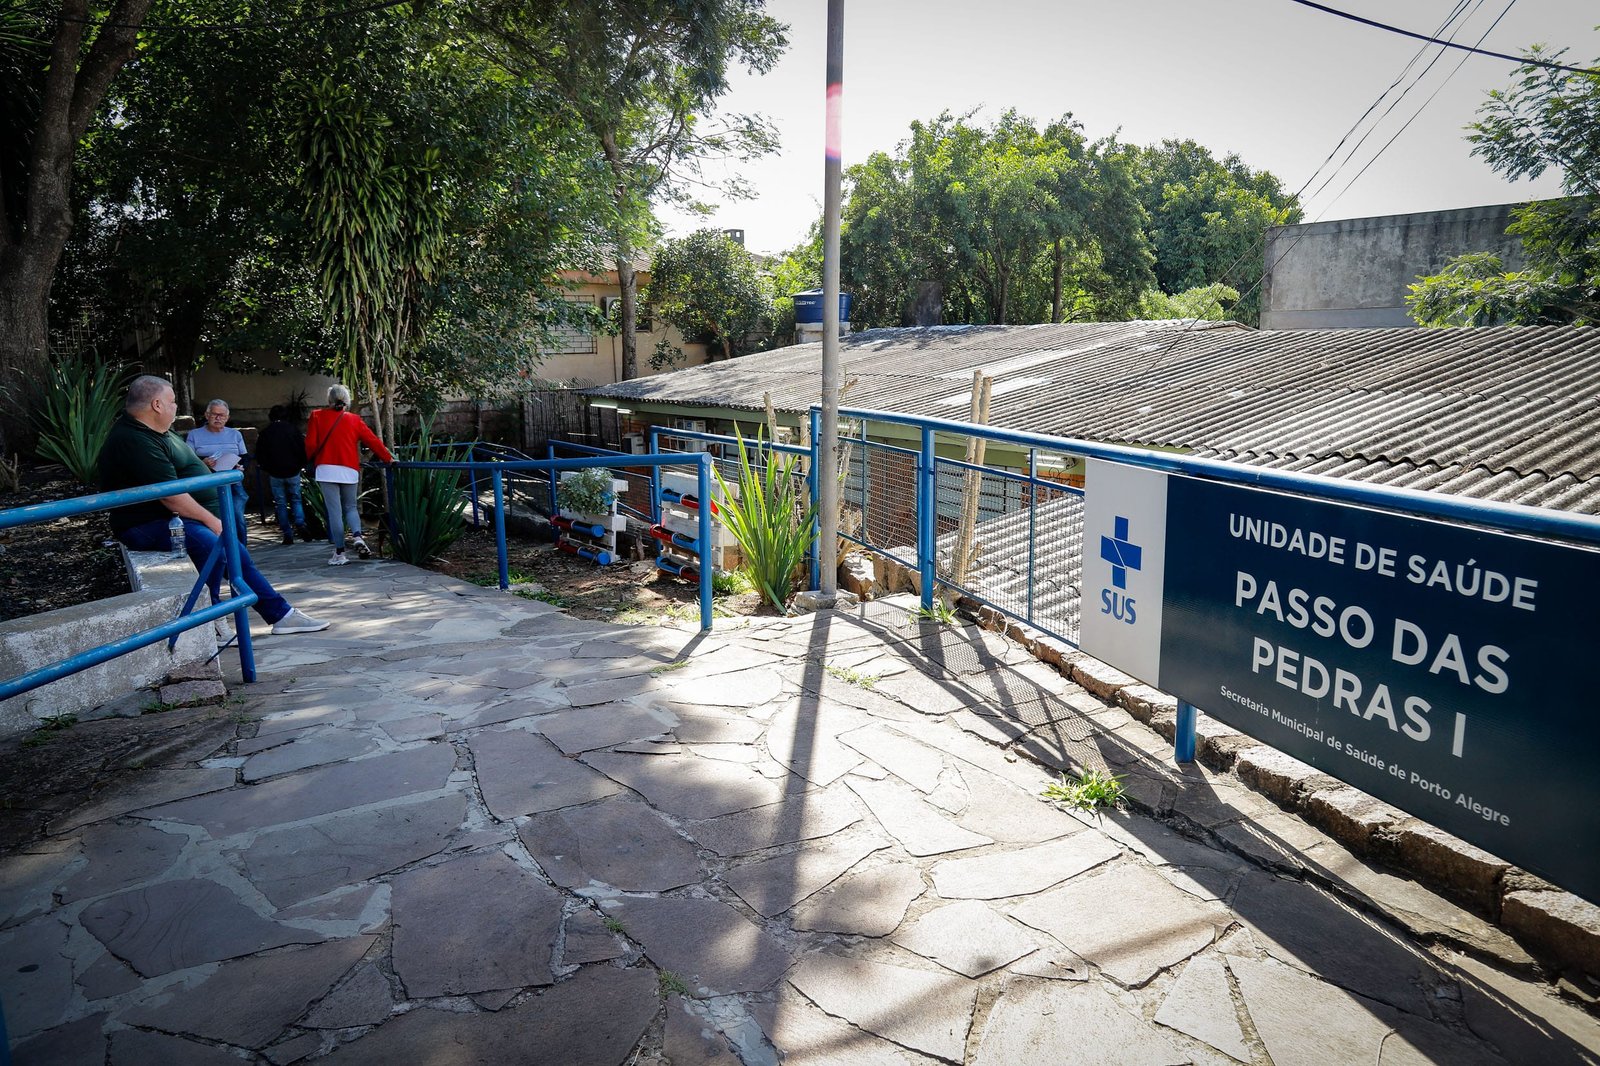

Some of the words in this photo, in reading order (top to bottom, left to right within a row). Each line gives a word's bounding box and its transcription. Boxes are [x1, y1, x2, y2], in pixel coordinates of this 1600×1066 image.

[1101, 588, 1136, 625] SUS
[1229, 513, 1346, 565] UNIDADE
[1355, 542, 1397, 578] DE
[1406, 554, 1538, 611] SAÚDE
[1235, 570, 1375, 649] PASSO
[1391, 618, 1510, 694] DAS
[1220, 685, 1269, 717] Secretaria
[1271, 708, 1325, 744] Municipal
[1326, 735, 1342, 751] de
[1345, 743, 1386, 771] Saúde
[1388, 763, 1407, 780] de
[1410, 771, 1451, 800] Porto
[1455, 793, 1511, 827] Alegre
[1252, 636, 1432, 742] PEDRAS
[1452, 711, 1466, 758] I
